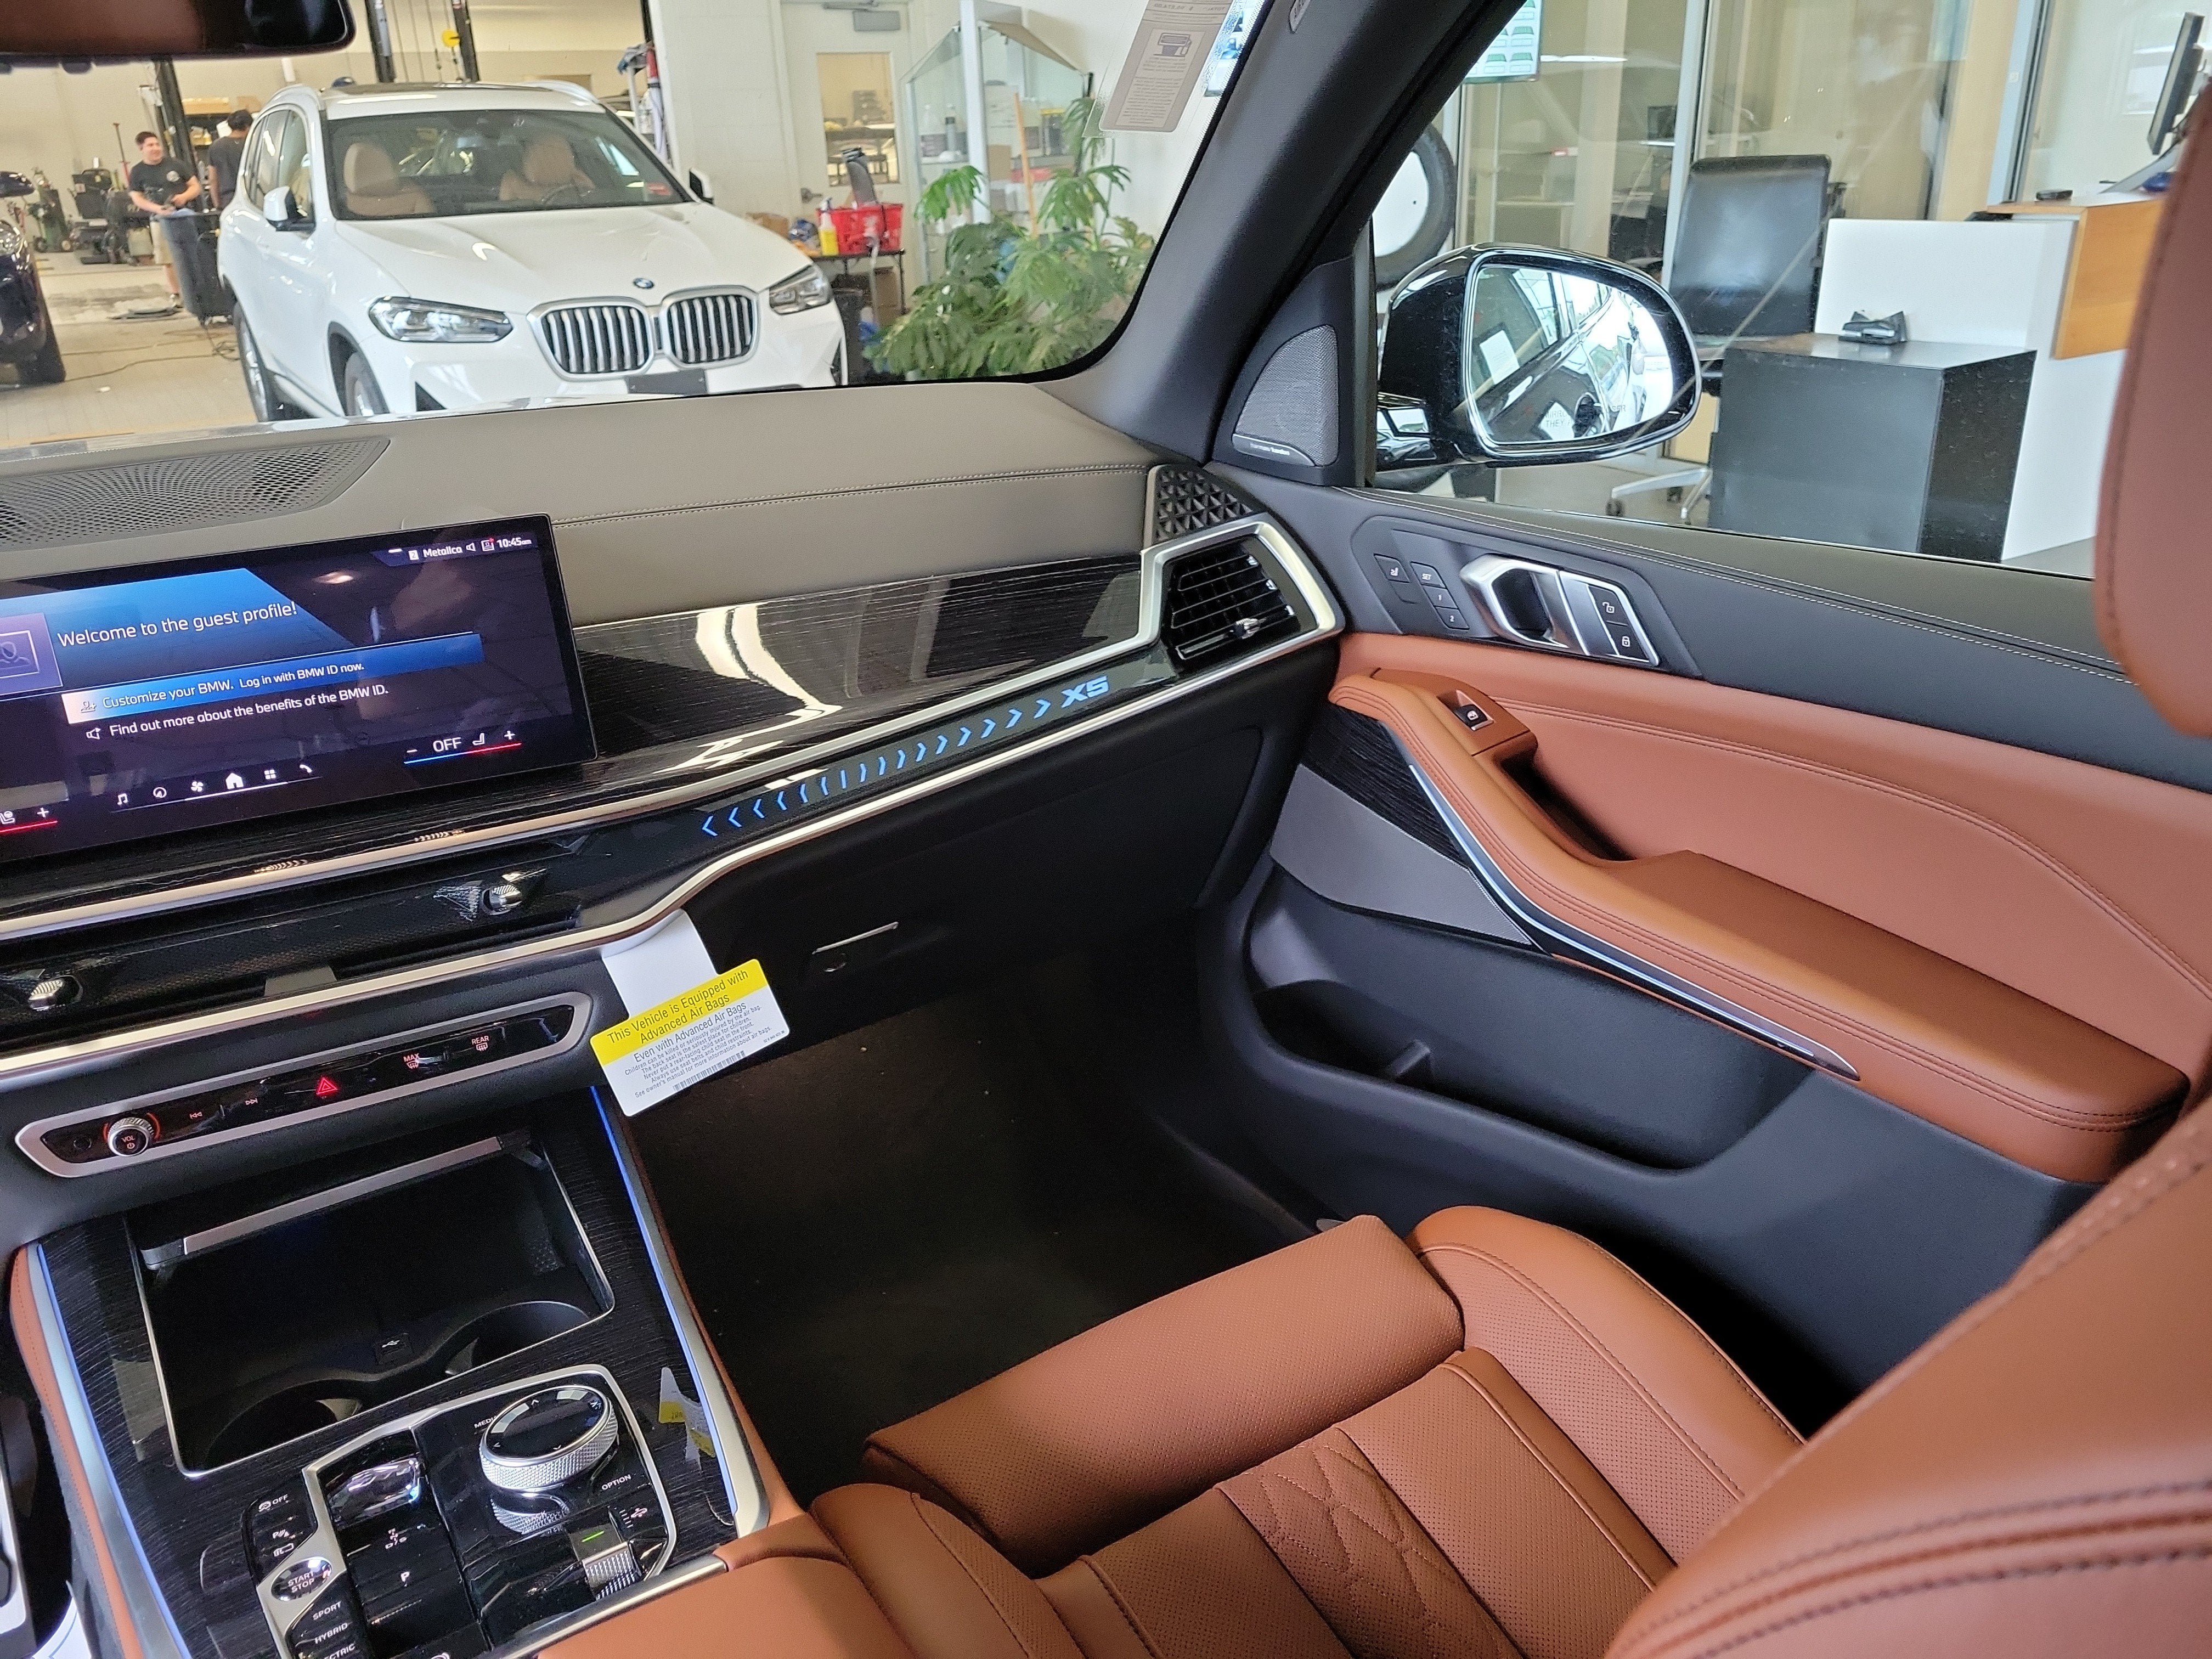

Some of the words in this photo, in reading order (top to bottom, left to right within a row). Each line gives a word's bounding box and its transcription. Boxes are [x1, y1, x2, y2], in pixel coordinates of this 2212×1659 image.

[57, 626, 137, 647] Welcome
[140, 623, 157, 636] to
[161, 618, 189, 633] the
[193, 611, 240, 631] guest
[242, 601, 297, 624] profile!
[103, 691, 167, 709] Customize
[168, 687, 196, 701] your
[198, 679, 234, 694] BMW.
[239, 676, 260, 689] Log
[262, 675, 272, 685] in
[273, 671, 296, 683] with
[297, 667, 324, 679] BMW
[327, 665, 338, 675] ID
[341, 663, 364, 673] now.
[1061, 676, 1109, 709] X5
[109, 722, 138, 737] Find
[140, 719, 161, 732] out
[163, 715, 195, 728] more
[197, 710, 233, 723] about
[234, 706, 254, 718] the
[255, 698, 302, 714] benefits
[304, 694, 316, 706] of
[318, 692, 337, 704] the
[338, 687, 370, 702] BMW
[373, 684, 389, 696] ID.
[433, 737, 462, 752] OFF
[607, 1027, 631, 1043] This
[631, 1009, 669, 1032] Vehicle
[669, 1004, 680, 1014] is
[680, 980, 726, 1009] Equipped
[727, 970, 748, 986] with
[640, 1013, 688, 1044] Advanced
[690, 1007, 704, 1020] Air
[706, 994, 730, 1012] Bags
[471, 1035, 489, 1045] REAR
[625, 1062, 646, 1075] Children
[665, 1045, 679, 1055] killed
[686, 1031, 708, 1045] seriously
[709, 1022, 727, 1033] injured
[634, 1048, 655, 1062] Even
[656, 1038, 674, 1051] with
[675, 1017, 713, 1043] Advanced
[715, 1013, 725, 1023] Air
[726, 1003, 746, 1017] Bags
[644, 1069, 658, 1080] Never
[660, 1064, 669, 1073] put
[674, 1049, 701, 1064] rear-facing
[702, 1041, 713, 1051] child
[714, 1036, 725, 1044] seat
[740, 1022, 754, 1031] front.
[652, 1060, 664, 1068] back
[692, 1038, 707, 1048] safest
[708, 1032, 721, 1042] place
[730, 1018, 751, 1029] children.
[403, 1053, 420, 1062] MAX
[646, 1080, 665, 1092] owner's
[667, 1069, 685, 1082] manual
[695, 1059, 707, 1068] more
[707, 1045, 736, 1060] information
[737, 1036, 751, 1046] about
[758, 1026, 771, 1035] bags.
[651, 1071, 669, 1083] Always
[680, 1060, 691, 1068] seat
[691, 1054, 704, 1062] belts
[715, 1041, 727, 1050] child
[728, 1030, 752, 1044] restraints.
[272, 1494, 289, 1505] OFF
[601, 1474, 631, 1491] OPTION
[288, 1571, 314, 1587] START
[291, 1578, 315, 1593] STOP
[400, 1571, 410, 1582] P
[312, 1601, 342, 1621] SPORT
[315, 1622, 348, 1644] HYBRID
